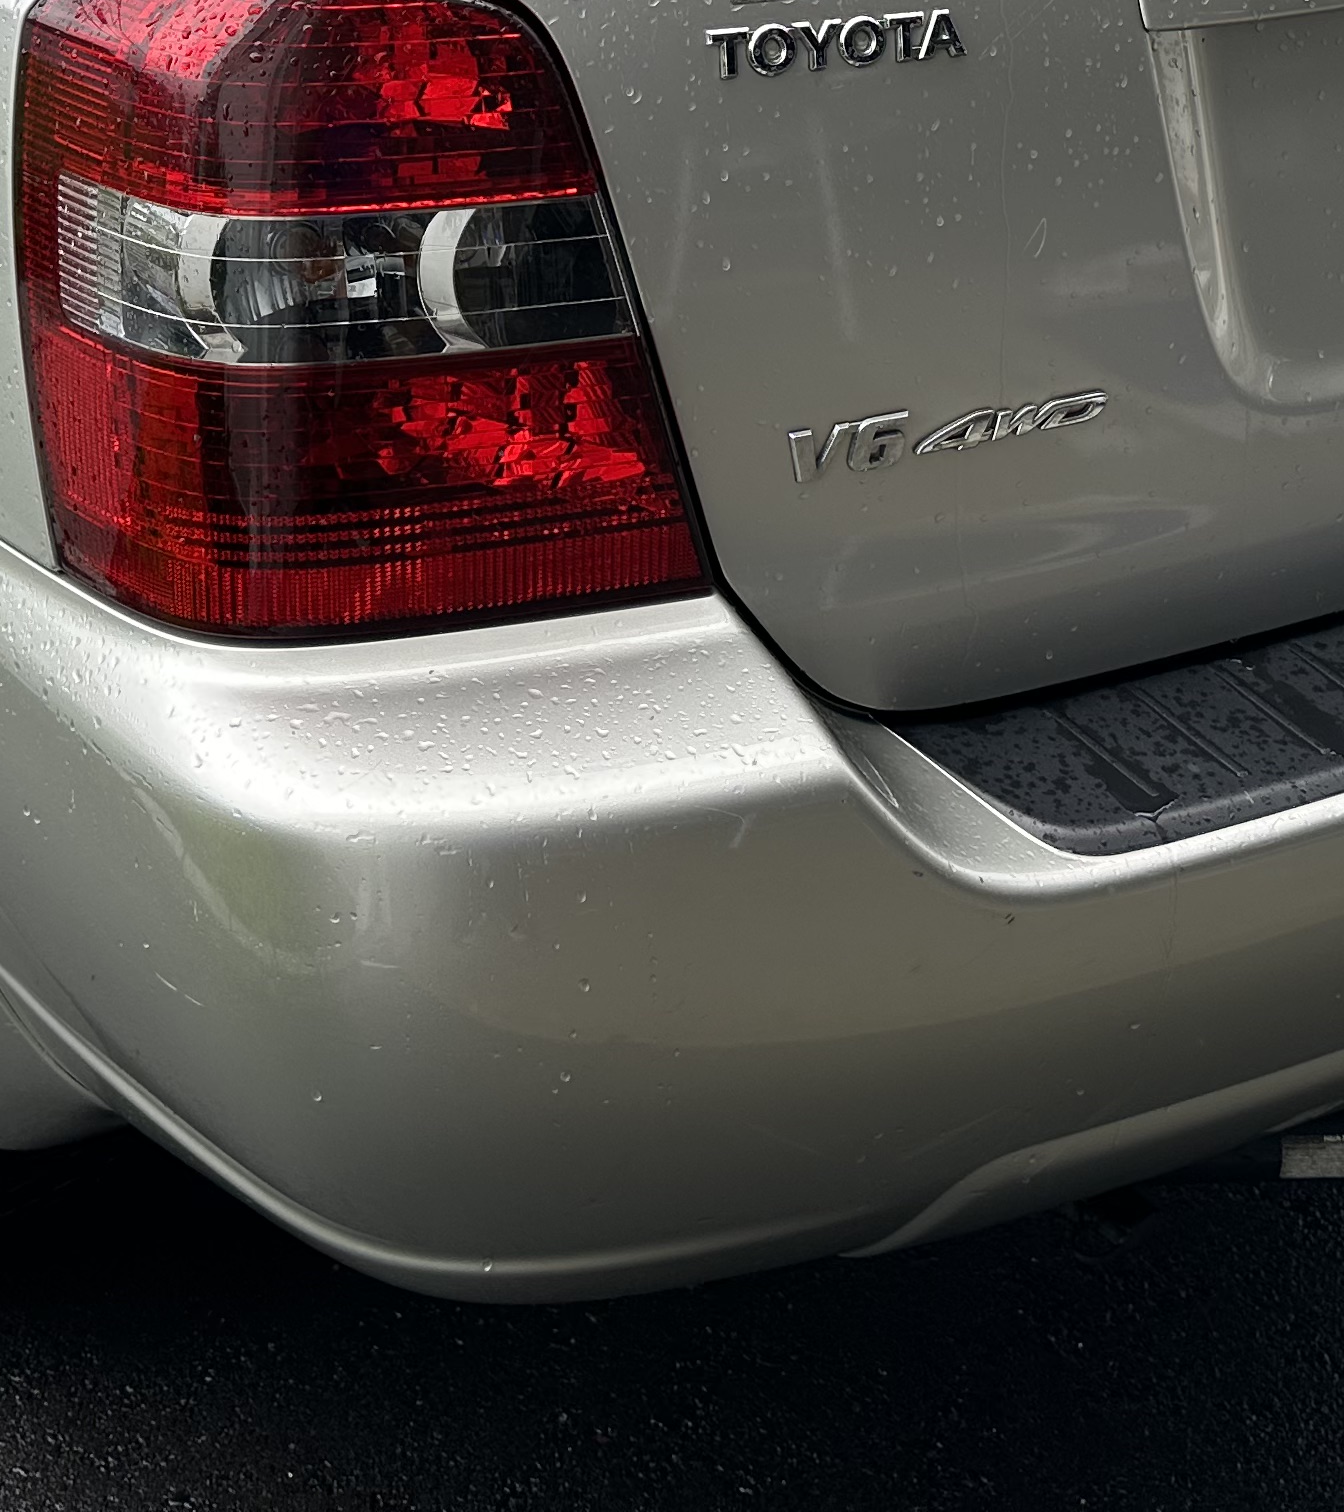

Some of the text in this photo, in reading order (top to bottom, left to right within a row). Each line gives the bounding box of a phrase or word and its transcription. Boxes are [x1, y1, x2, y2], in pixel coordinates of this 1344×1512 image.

[705, 8, 968, 80] TOYOTA
[788, 389, 1110, 484] V6 4WD
